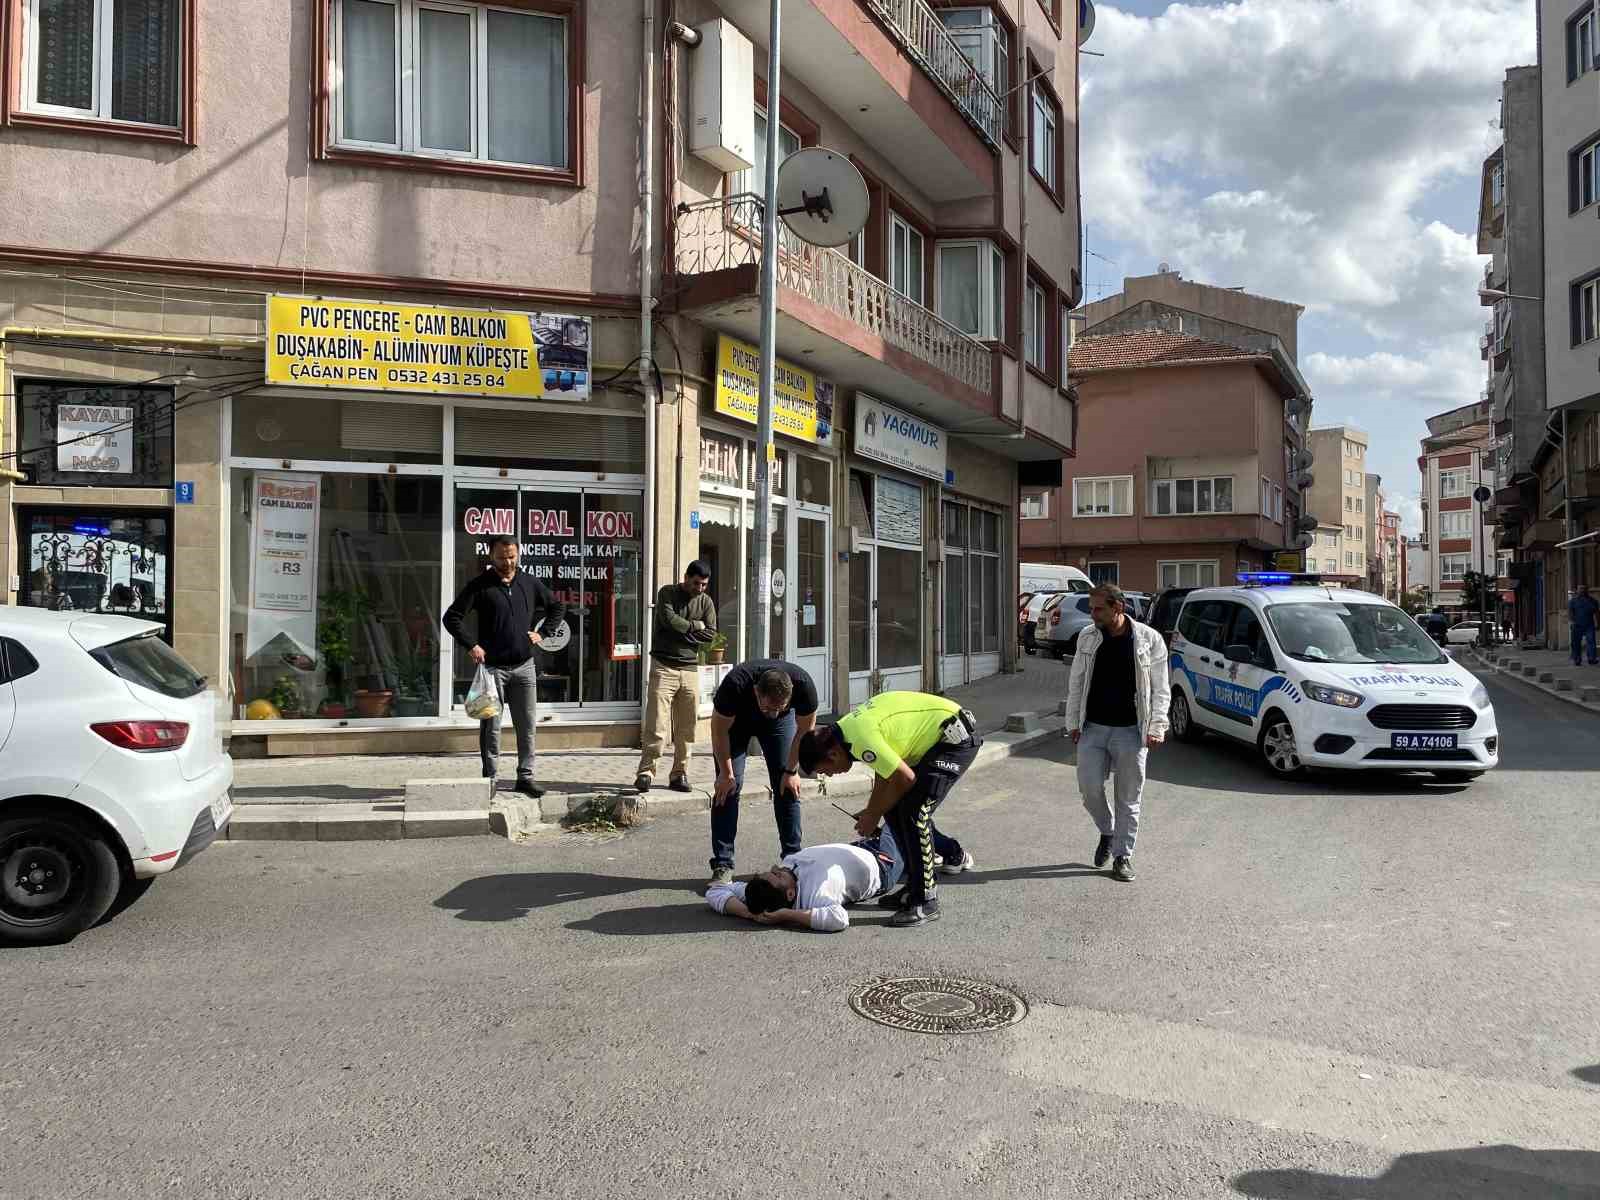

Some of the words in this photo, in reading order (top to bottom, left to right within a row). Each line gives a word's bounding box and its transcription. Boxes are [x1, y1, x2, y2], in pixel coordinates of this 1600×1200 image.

[300, 306, 329, 329] PVC
[334, 308, 400, 333] PENCERE
[415, 314, 446, 336] CAM
[450, 316, 506, 339] BALKON
[373, 337, 461, 367] ALÜMİNYUM
[466, 344, 529, 373] KÜPEŞTE
[290, 361, 343, 380] ÇAĞAN
[348, 367, 378, 381] PEN
[388, 369, 428, 383] 0532
[431, 371, 460, 385] 431
[463, 373, 483, 386] 25
[485, 374, 505, 387] 84
[181, 483, 189, 496] 9
[464, 507, 514, 535] CAM
[520, 544, 555, 556] NCERE
[597, 545, 622, 557] KAPI
[1396, 736, 1408, 747] 59
[1411, 736, 1419, 747] A
